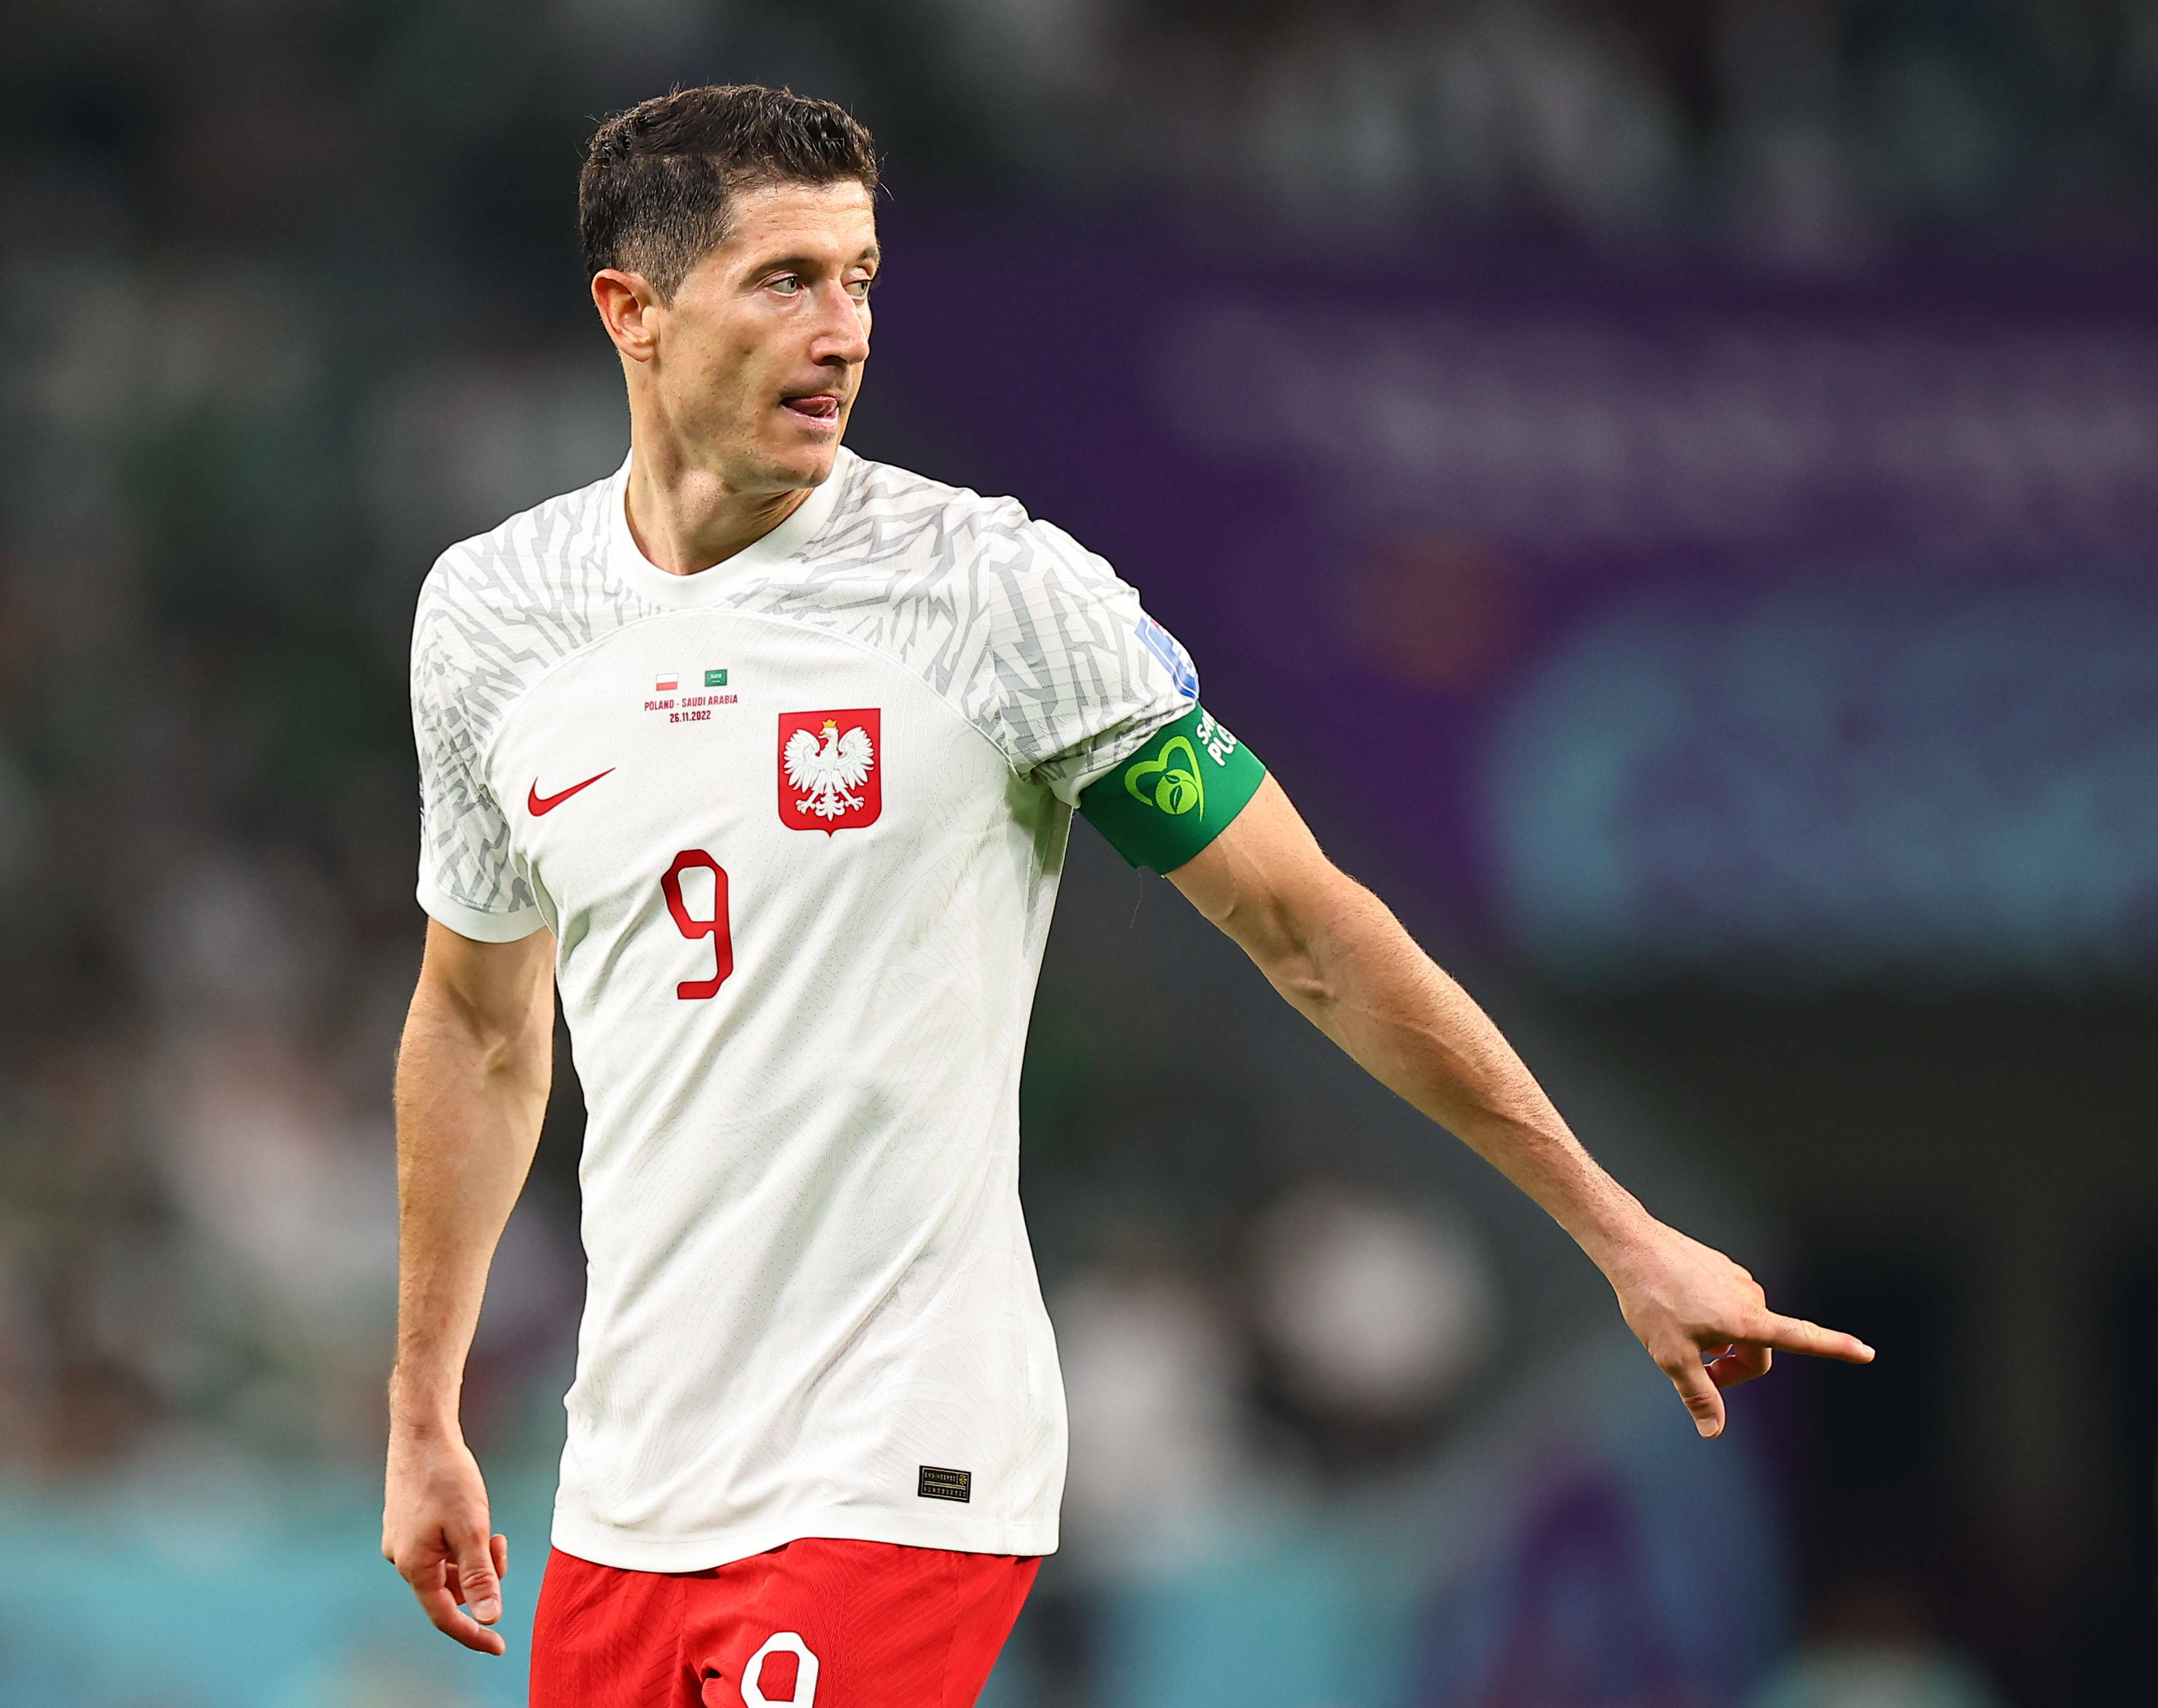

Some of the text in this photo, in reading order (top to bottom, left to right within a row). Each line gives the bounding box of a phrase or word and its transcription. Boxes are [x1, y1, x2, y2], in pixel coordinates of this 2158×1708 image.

[644, 699, 674, 711] POLAND
[682, 697, 705, 708] SAUDI
[708, 695, 737, 705] ARABIA
[670, 710, 711, 723] 26.11.2022
[661, 849, 733, 999] 9
